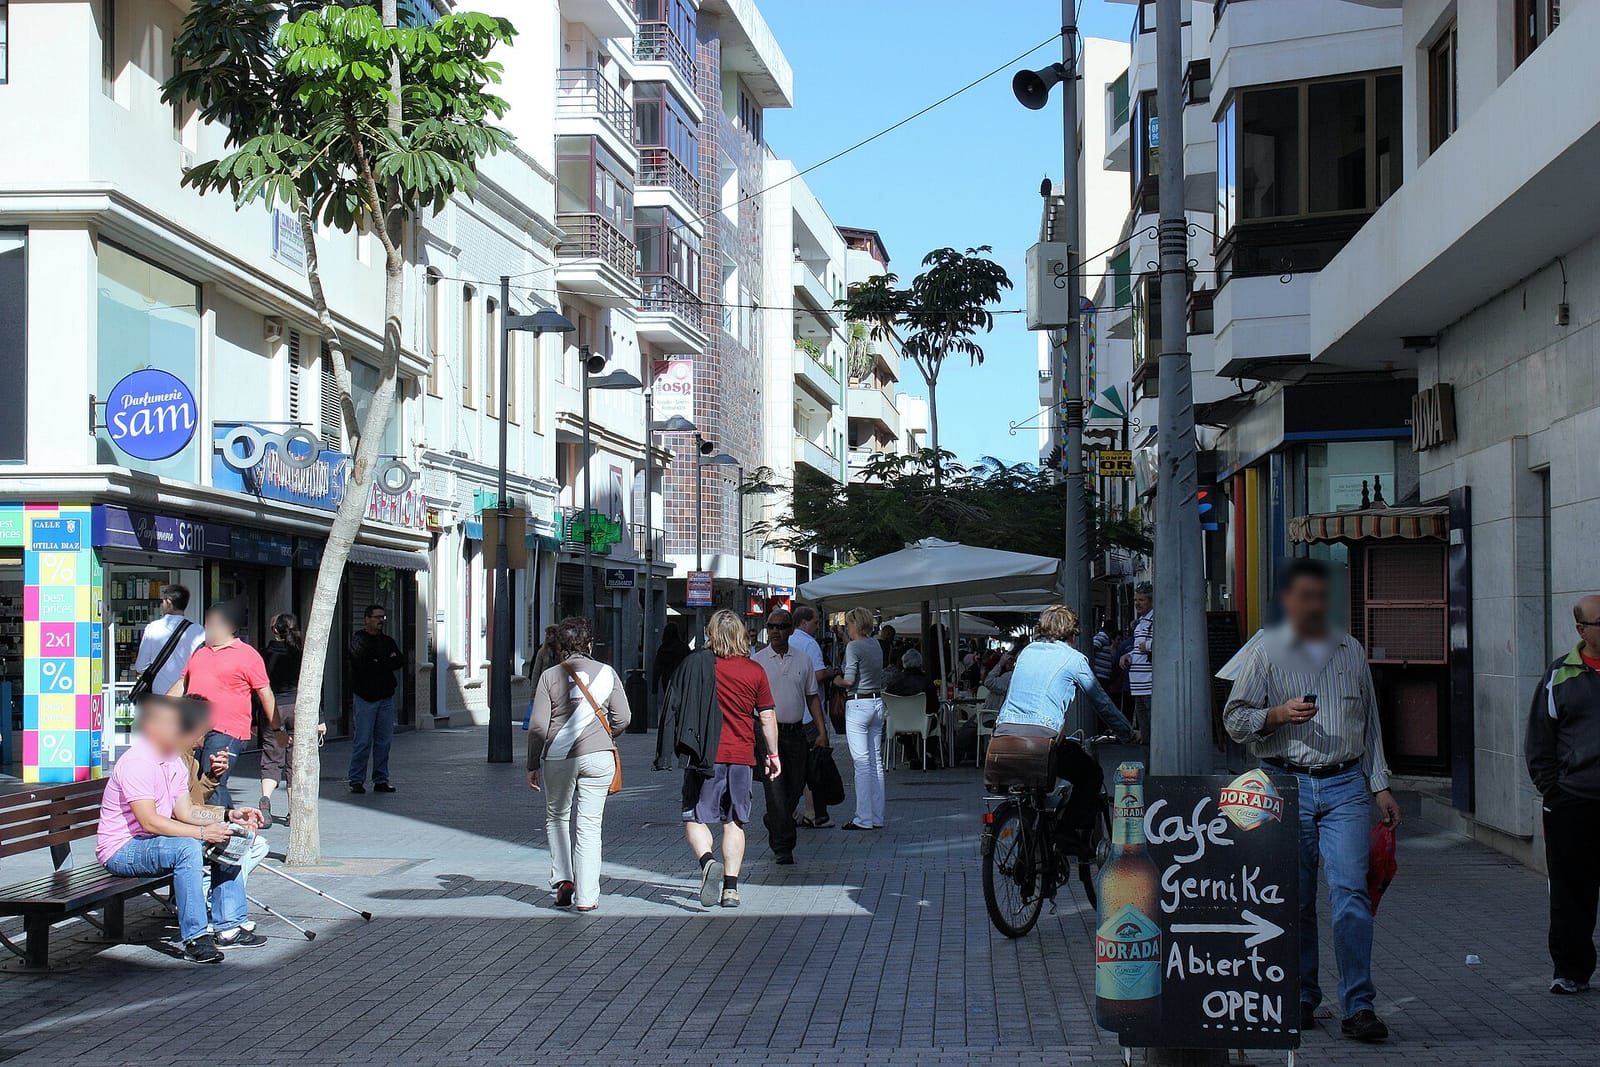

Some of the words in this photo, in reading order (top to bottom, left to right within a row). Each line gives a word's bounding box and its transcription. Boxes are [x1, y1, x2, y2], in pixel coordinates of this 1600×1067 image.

[121, 389, 183, 409] Parfumerie
[112, 402, 195, 439] sam
[1411, 383, 1444, 453] BBVA
[34, 521, 61, 529] CALLE
[178, 521, 206, 552] sam
[32, 542, 58, 550] OTILIA
[61, 542, 80, 550] DIAZ
[45, 632, 70, 648] 2x1
[43, 661, 73, 690] %
[1220, 791, 1281, 814] DORADA
[1099, 940, 1160, 960] DORADA
[1166, 941, 1285, 983] Abierto
[1202, 990, 1282, 1025] OPEN
